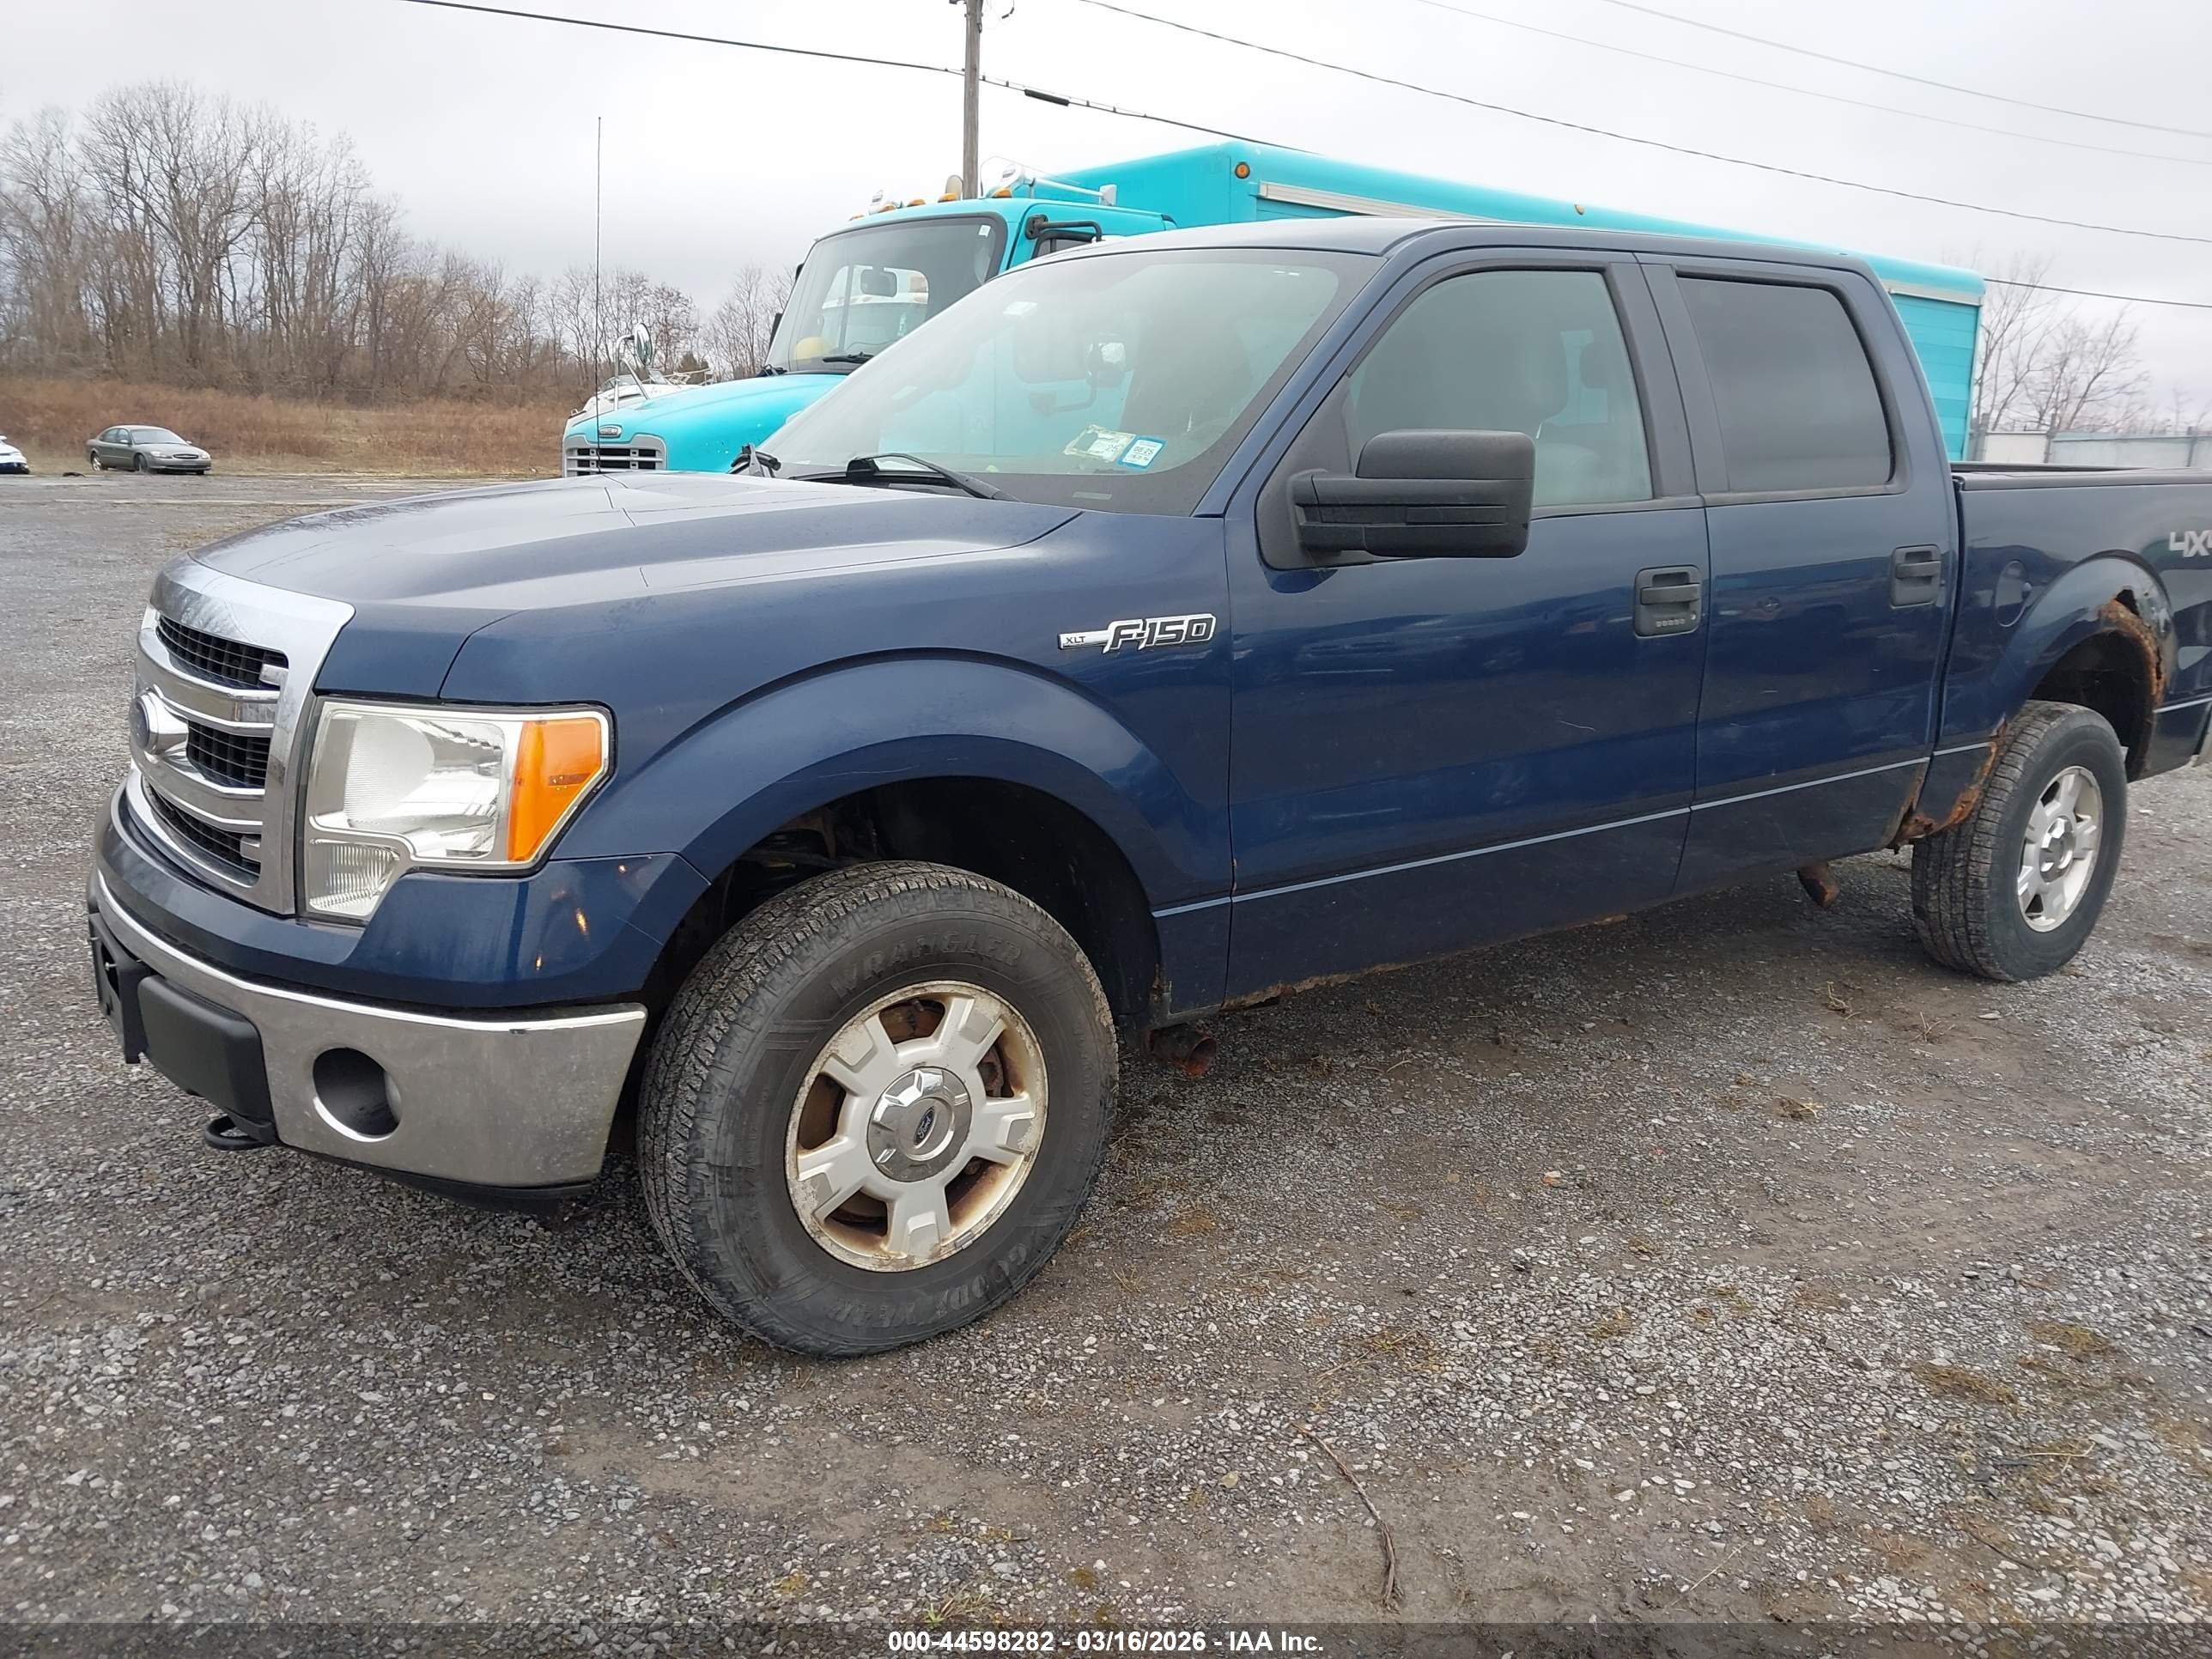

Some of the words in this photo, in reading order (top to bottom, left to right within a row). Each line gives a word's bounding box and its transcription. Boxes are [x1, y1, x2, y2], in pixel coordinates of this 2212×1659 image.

[2169, 530, 2212, 558] 4X
[1065, 635, 1086, 645] XLT
[1101, 612, 1217, 654] F-150
